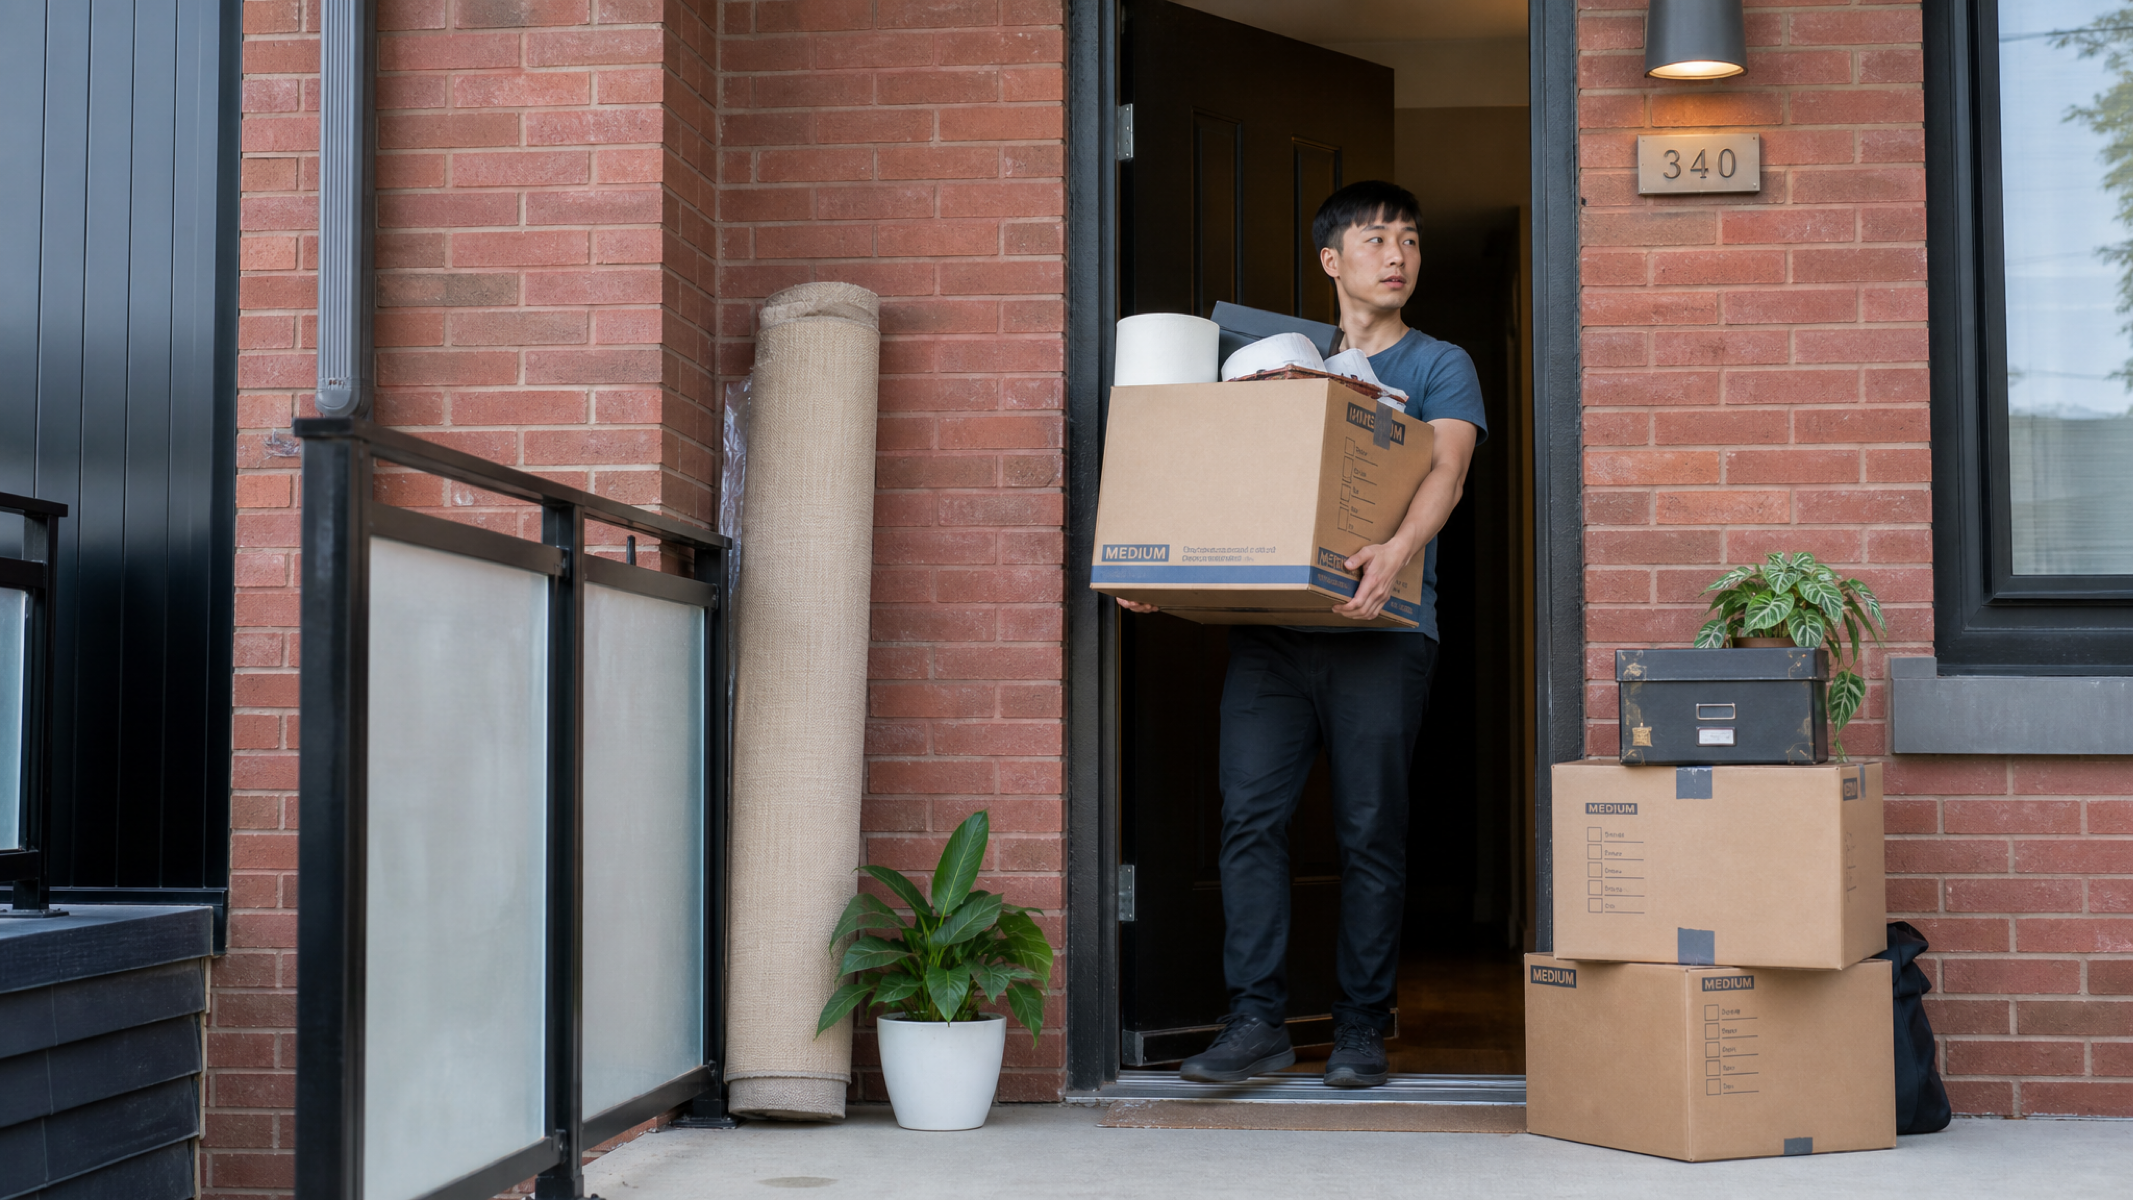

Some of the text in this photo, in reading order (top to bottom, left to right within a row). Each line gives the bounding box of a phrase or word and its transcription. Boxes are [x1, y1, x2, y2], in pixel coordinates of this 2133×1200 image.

[1662, 147, 1737, 180] 340
[1104, 546, 1167, 560] MEDIUM
[1588, 803, 1636, 814] MEDIUM
[1532, 968, 1575, 986] MEDIUM
[1703, 977, 1753, 991] MEDIUM
